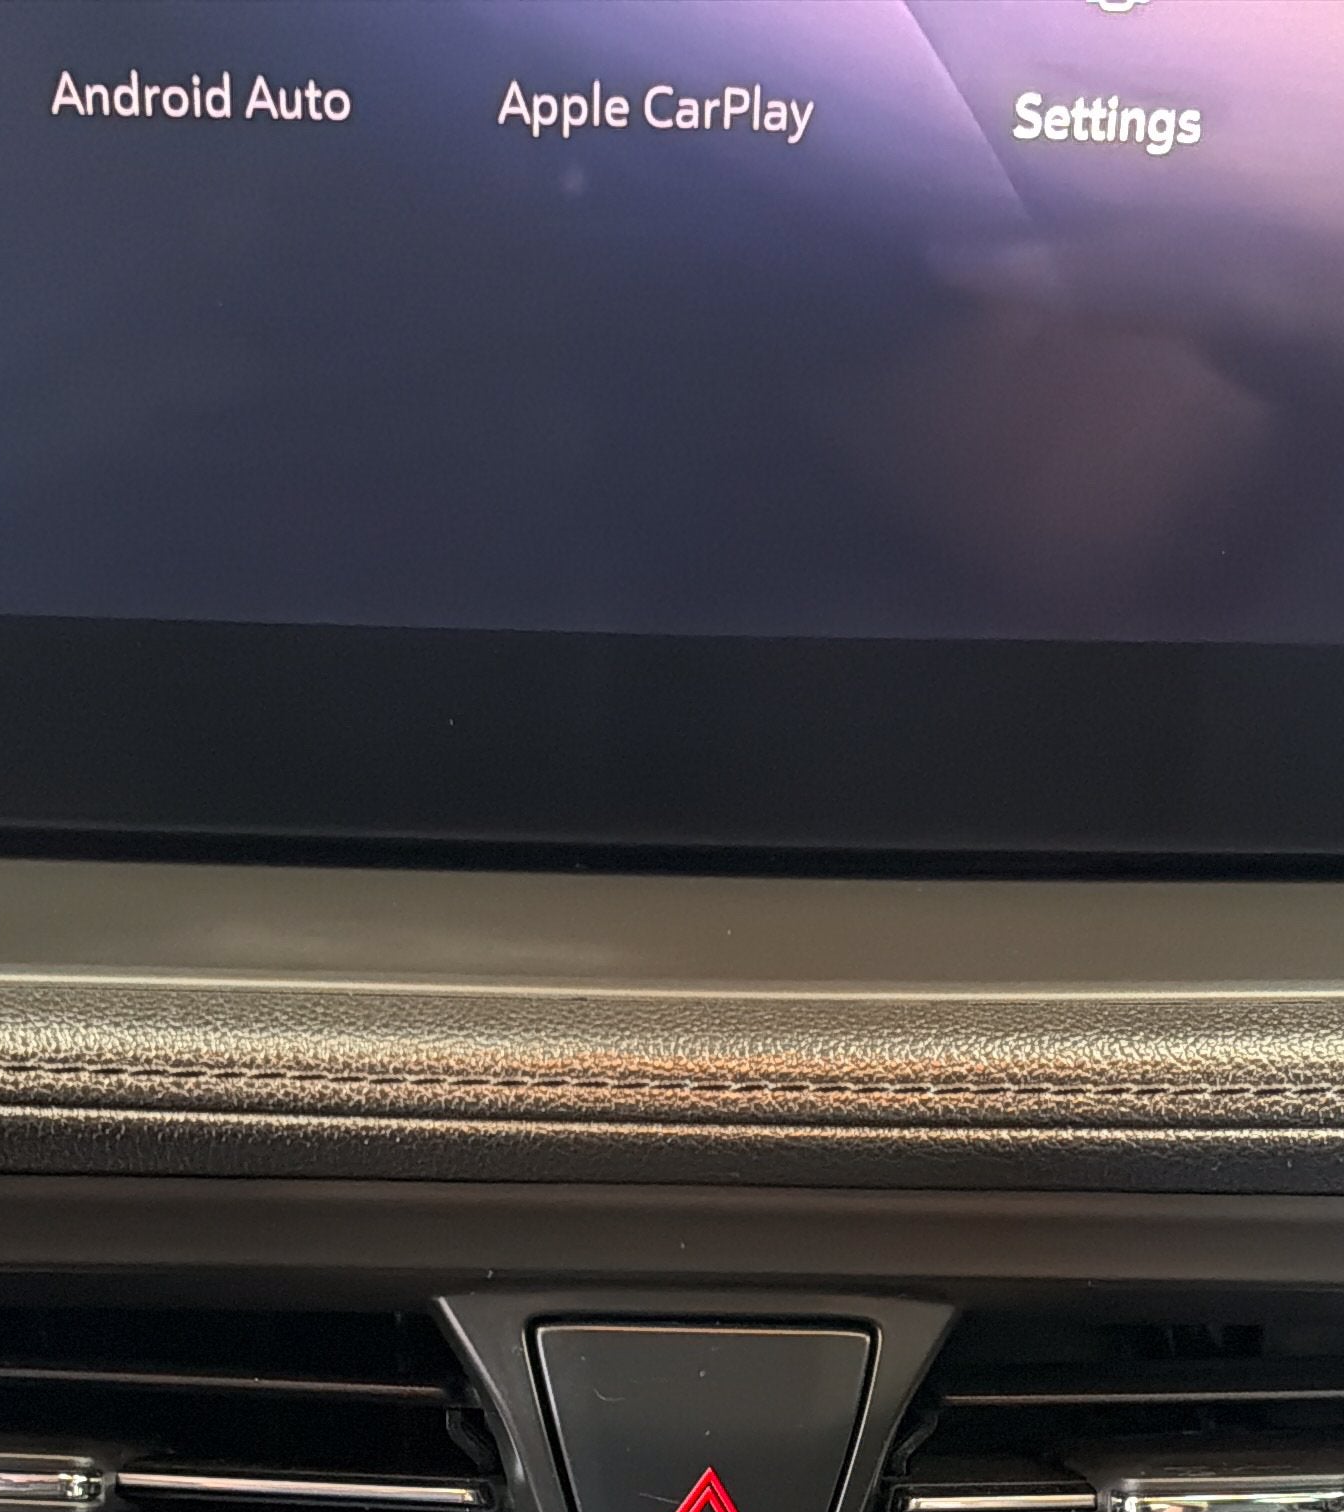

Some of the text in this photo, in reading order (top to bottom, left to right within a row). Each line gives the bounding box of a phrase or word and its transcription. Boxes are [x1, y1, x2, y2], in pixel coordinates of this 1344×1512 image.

[51, 70, 351, 122] Android Auto
[497, 80, 815, 145] Apple CarPlay
[1012, 92, 1202, 156] Settings
